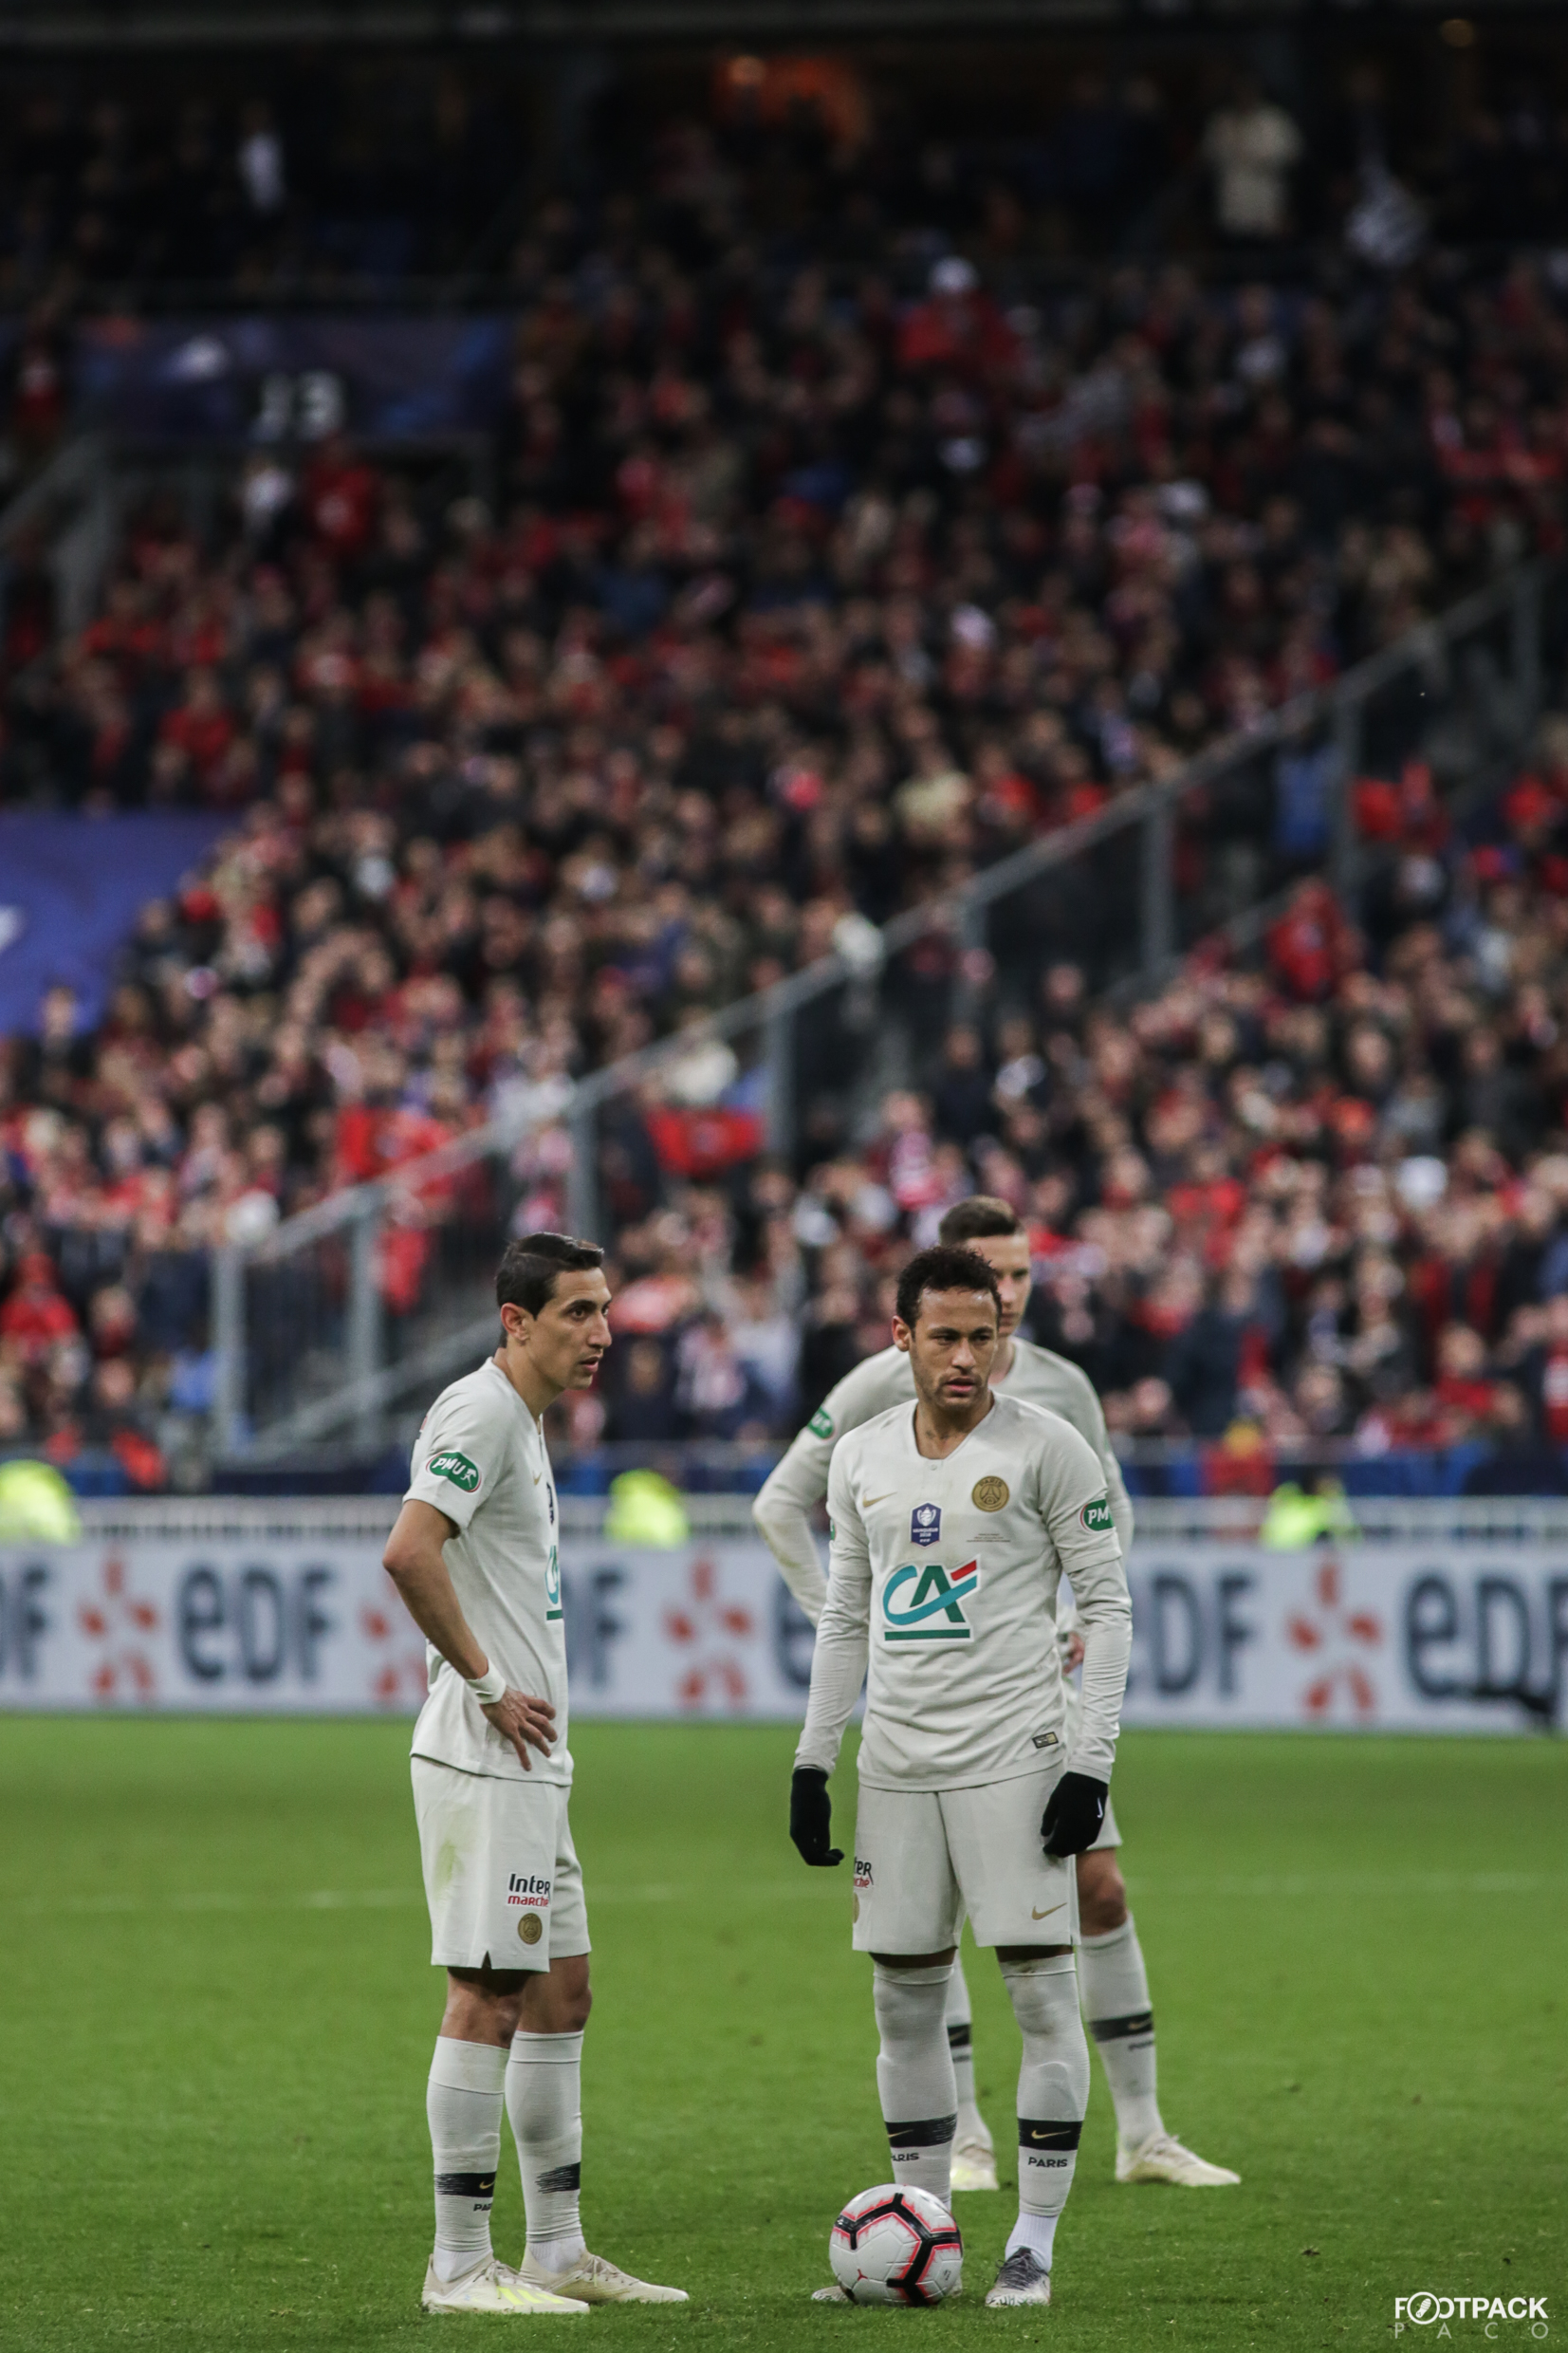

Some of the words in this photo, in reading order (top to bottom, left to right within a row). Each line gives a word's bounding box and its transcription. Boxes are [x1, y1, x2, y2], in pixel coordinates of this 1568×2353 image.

[432, 1457, 467, 1475] PMU
[1087, 1504, 1110, 1525] PM
[891, 2152, 920, 2162] ARIS
[1027, 2157, 1068, 2169] PARIS
